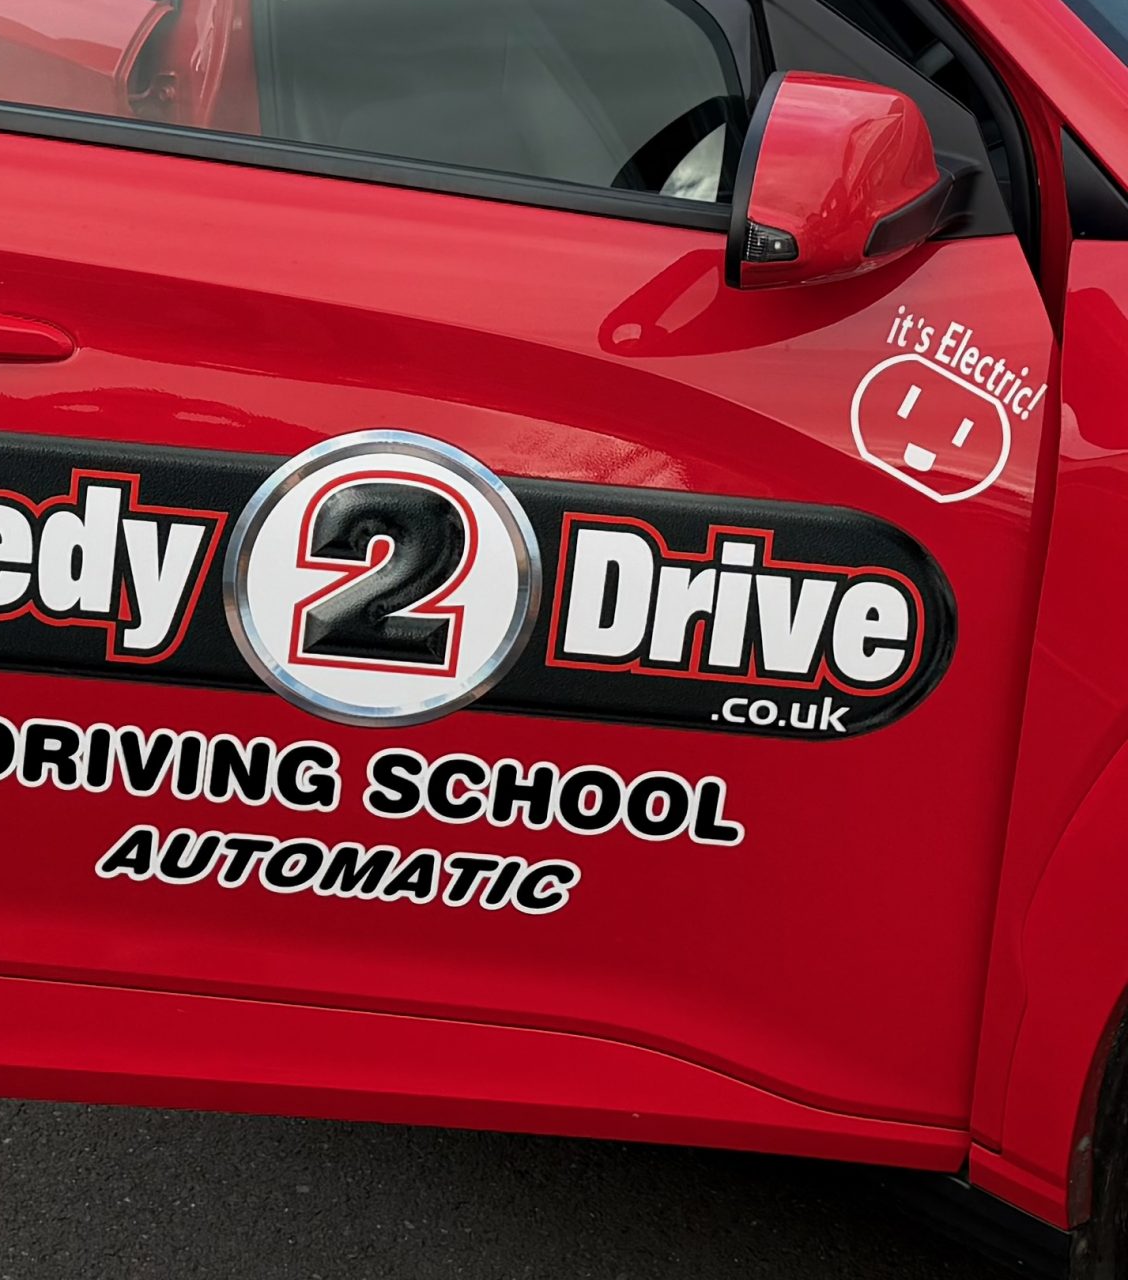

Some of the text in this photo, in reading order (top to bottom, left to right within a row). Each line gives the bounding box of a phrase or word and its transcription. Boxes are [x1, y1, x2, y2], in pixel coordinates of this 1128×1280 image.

[886, 305, 1048, 421] it's Electric!
[299, 480, 469, 668] 2
[562, 527, 910, 683] Drive
[710, 696, 851, 733] .co.uk
[363, 748, 744, 846] SCHOOL
[95, 825, 580, 914] AUTOMATIC
